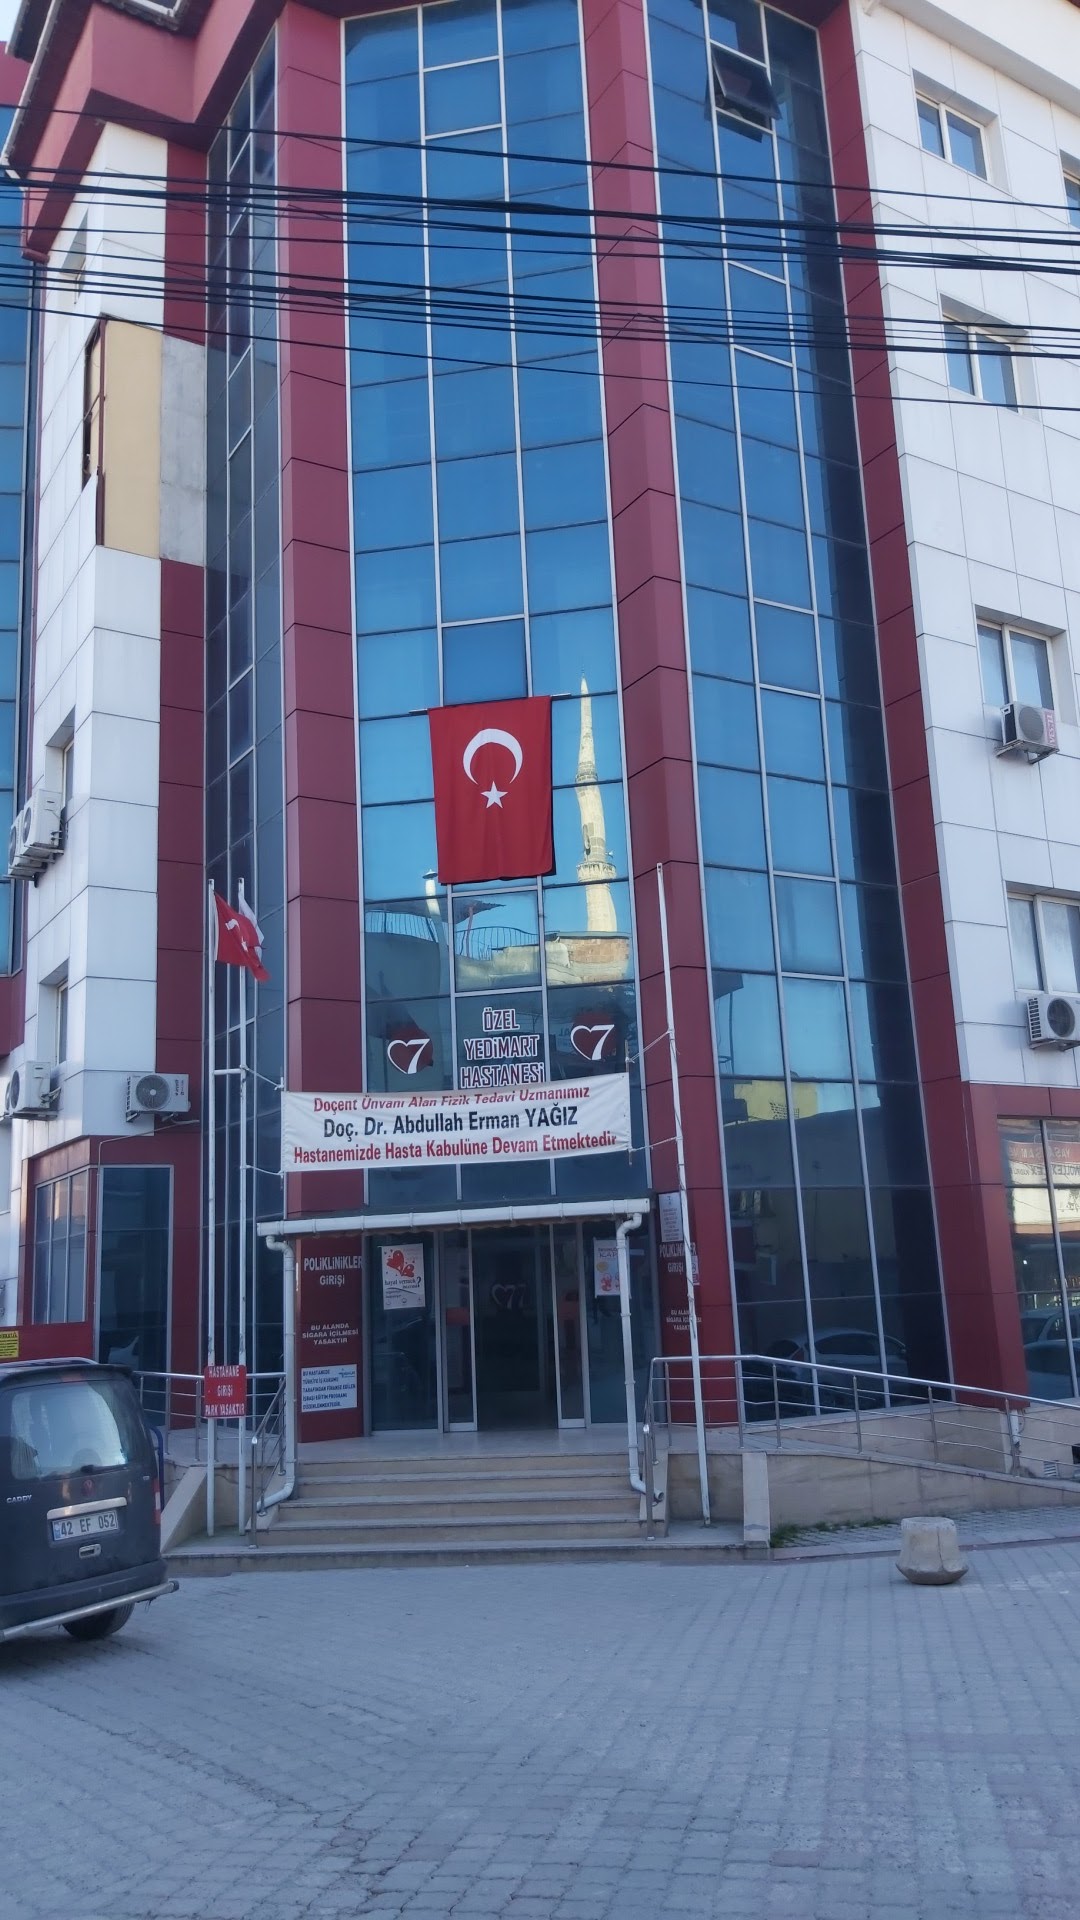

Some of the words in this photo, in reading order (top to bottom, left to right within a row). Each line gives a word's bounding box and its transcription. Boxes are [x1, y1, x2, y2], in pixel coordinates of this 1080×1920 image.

[482, 1006, 520, 1033] ÖZEL
[314, 1097, 357, 1115] Doçent
[361, 1094, 405, 1110] Ünvanı
[408, 1096, 437, 1108] Alan
[441, 1095, 469, 1106] Fizik
[474, 1091, 515, 1104] Tedavi
[519, 1087, 590, 1101] Uzmanımız
[323, 1118, 358, 1142] Doç.
[364, 1116, 387, 1136] Dr.
[393, 1112, 463, 1135] Abdullah
[468, 1111, 520, 1131] Erman
[524, 1102, 578, 1127] YAĞIZ
[294, 1143, 381, 1164] Hastanemizde
[385, 1142, 422, 1160] Hasta
[426, 1138, 488, 1161] Kabulüne
[492, 1136, 538, 1154] Devam
[542, 1130, 617, 1151] Etmektedir
[302, 1331, 328, 1339] SİGARA
[322, 1322, 350, 1330] ALANDA
[313, 1337, 348, 1345] YASAKTIR
[205, 1404, 218, 1416] PARK
[219, 1403, 245, 1416] YASAKTIR
[6, 1494, 33, 1504] CADDY
[61, 1521, 74, 1537] 42
[79, 1518, 91, 1533] EF
[98, 1513, 116, 1529] 052
